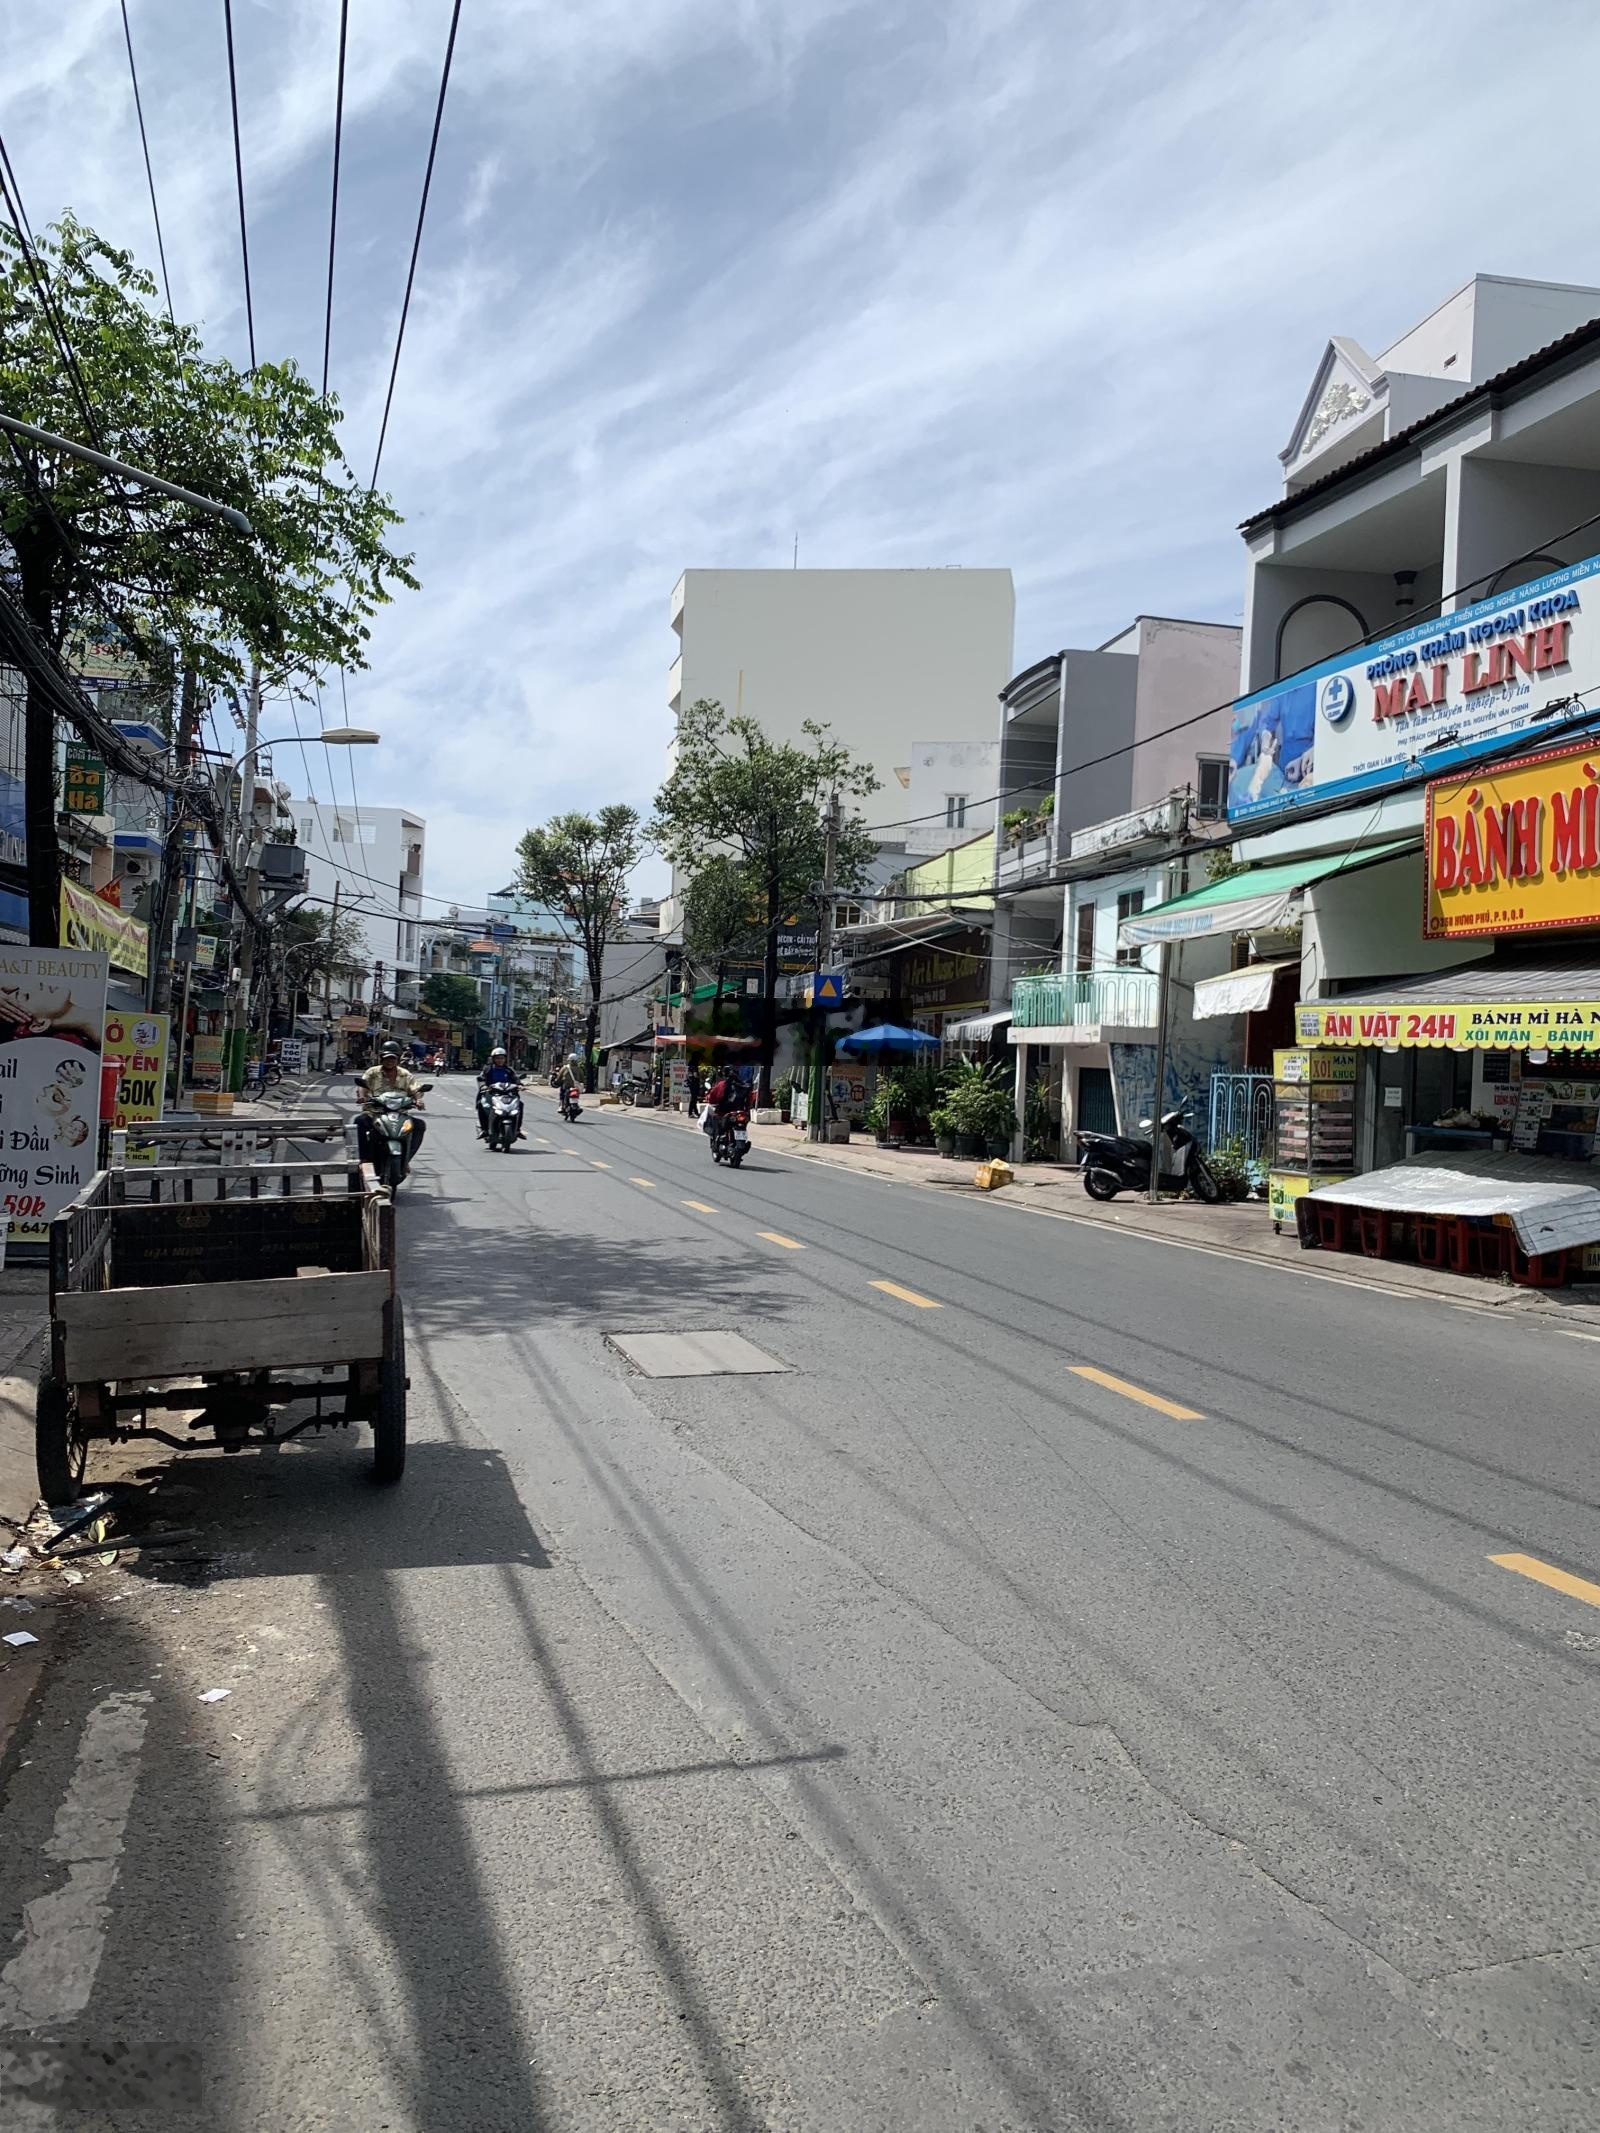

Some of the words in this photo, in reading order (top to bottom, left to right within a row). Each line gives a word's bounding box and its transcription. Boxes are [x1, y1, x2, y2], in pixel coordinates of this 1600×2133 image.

[1541, 572, 1570, 590] LƯỢNG
[1571, 564, 1590, 578] MIỀN
[1366, 649, 1417, 681] PHÒNG
[1420, 630, 1465, 662] KHÁM
[1469, 609, 1526, 645] NGOẠI
[1527, 589, 1580, 622] KHOA
[1372, 664, 1449, 722] MAI
[1461, 620, 1572, 694] LINH
[1434, 788, 1541, 890] BÁNH
[1549, 762, 1600, 873] MÌ
[1454, 913, 1474, 927] HƯNG
[0, 958, 32, 975] A&T
[37, 960, 102, 979] BEAUTY
[1324, 1011, 1352, 1037] ĂN
[1359, 1010, 1401, 1041] VẶT
[1406, 1014, 1456, 1038] 24H
[1472, 1009, 1522, 1025] BÁNH
[1527, 1009, 1550, 1025] MÌ
[1554, 1008, 1584, 1025] HÀ
[1465, 1028, 1489, 1041] XÔI
[1494, 1028, 1531, 1044] MẶN
[1547, 1028, 1594, 1042] BÁNH
[10, 1125, 50, 1151] Đầu
[34, 1164, 80, 1186] Sinh
